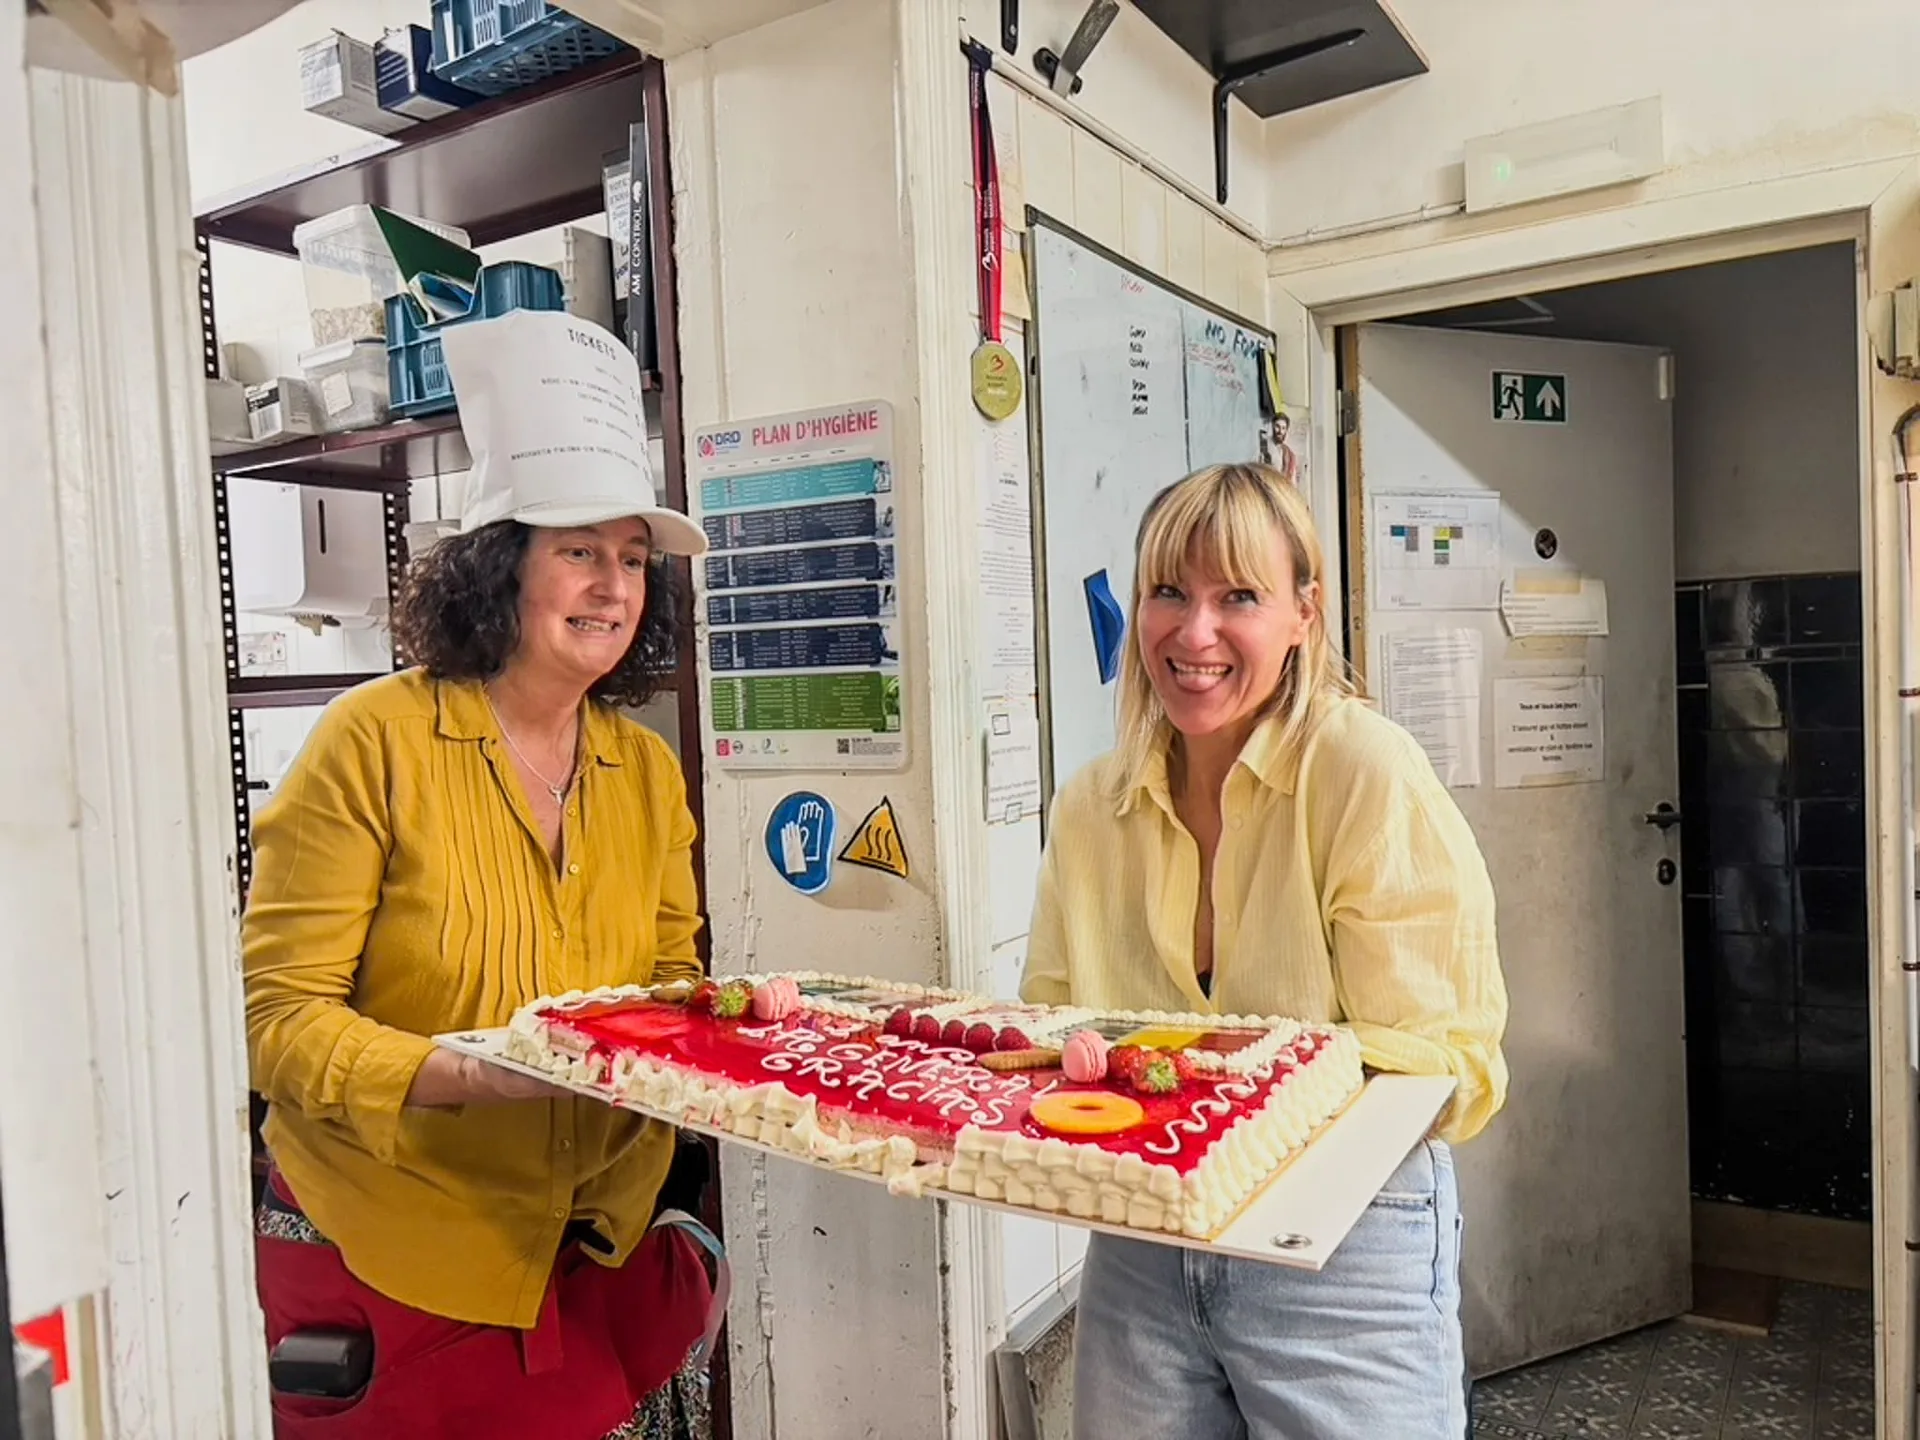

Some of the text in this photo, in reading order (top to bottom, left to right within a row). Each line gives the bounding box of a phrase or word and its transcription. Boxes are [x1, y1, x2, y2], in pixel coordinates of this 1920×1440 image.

[631, 206, 642, 268] CONTROL
[567, 327, 617, 362] TICKETS
[752, 408, 879, 447] PLAN D'HYGIÈNE
[760, 1052, 1013, 1127] GRACIAS
[827, 1043, 1059, 1100] GENERAL
